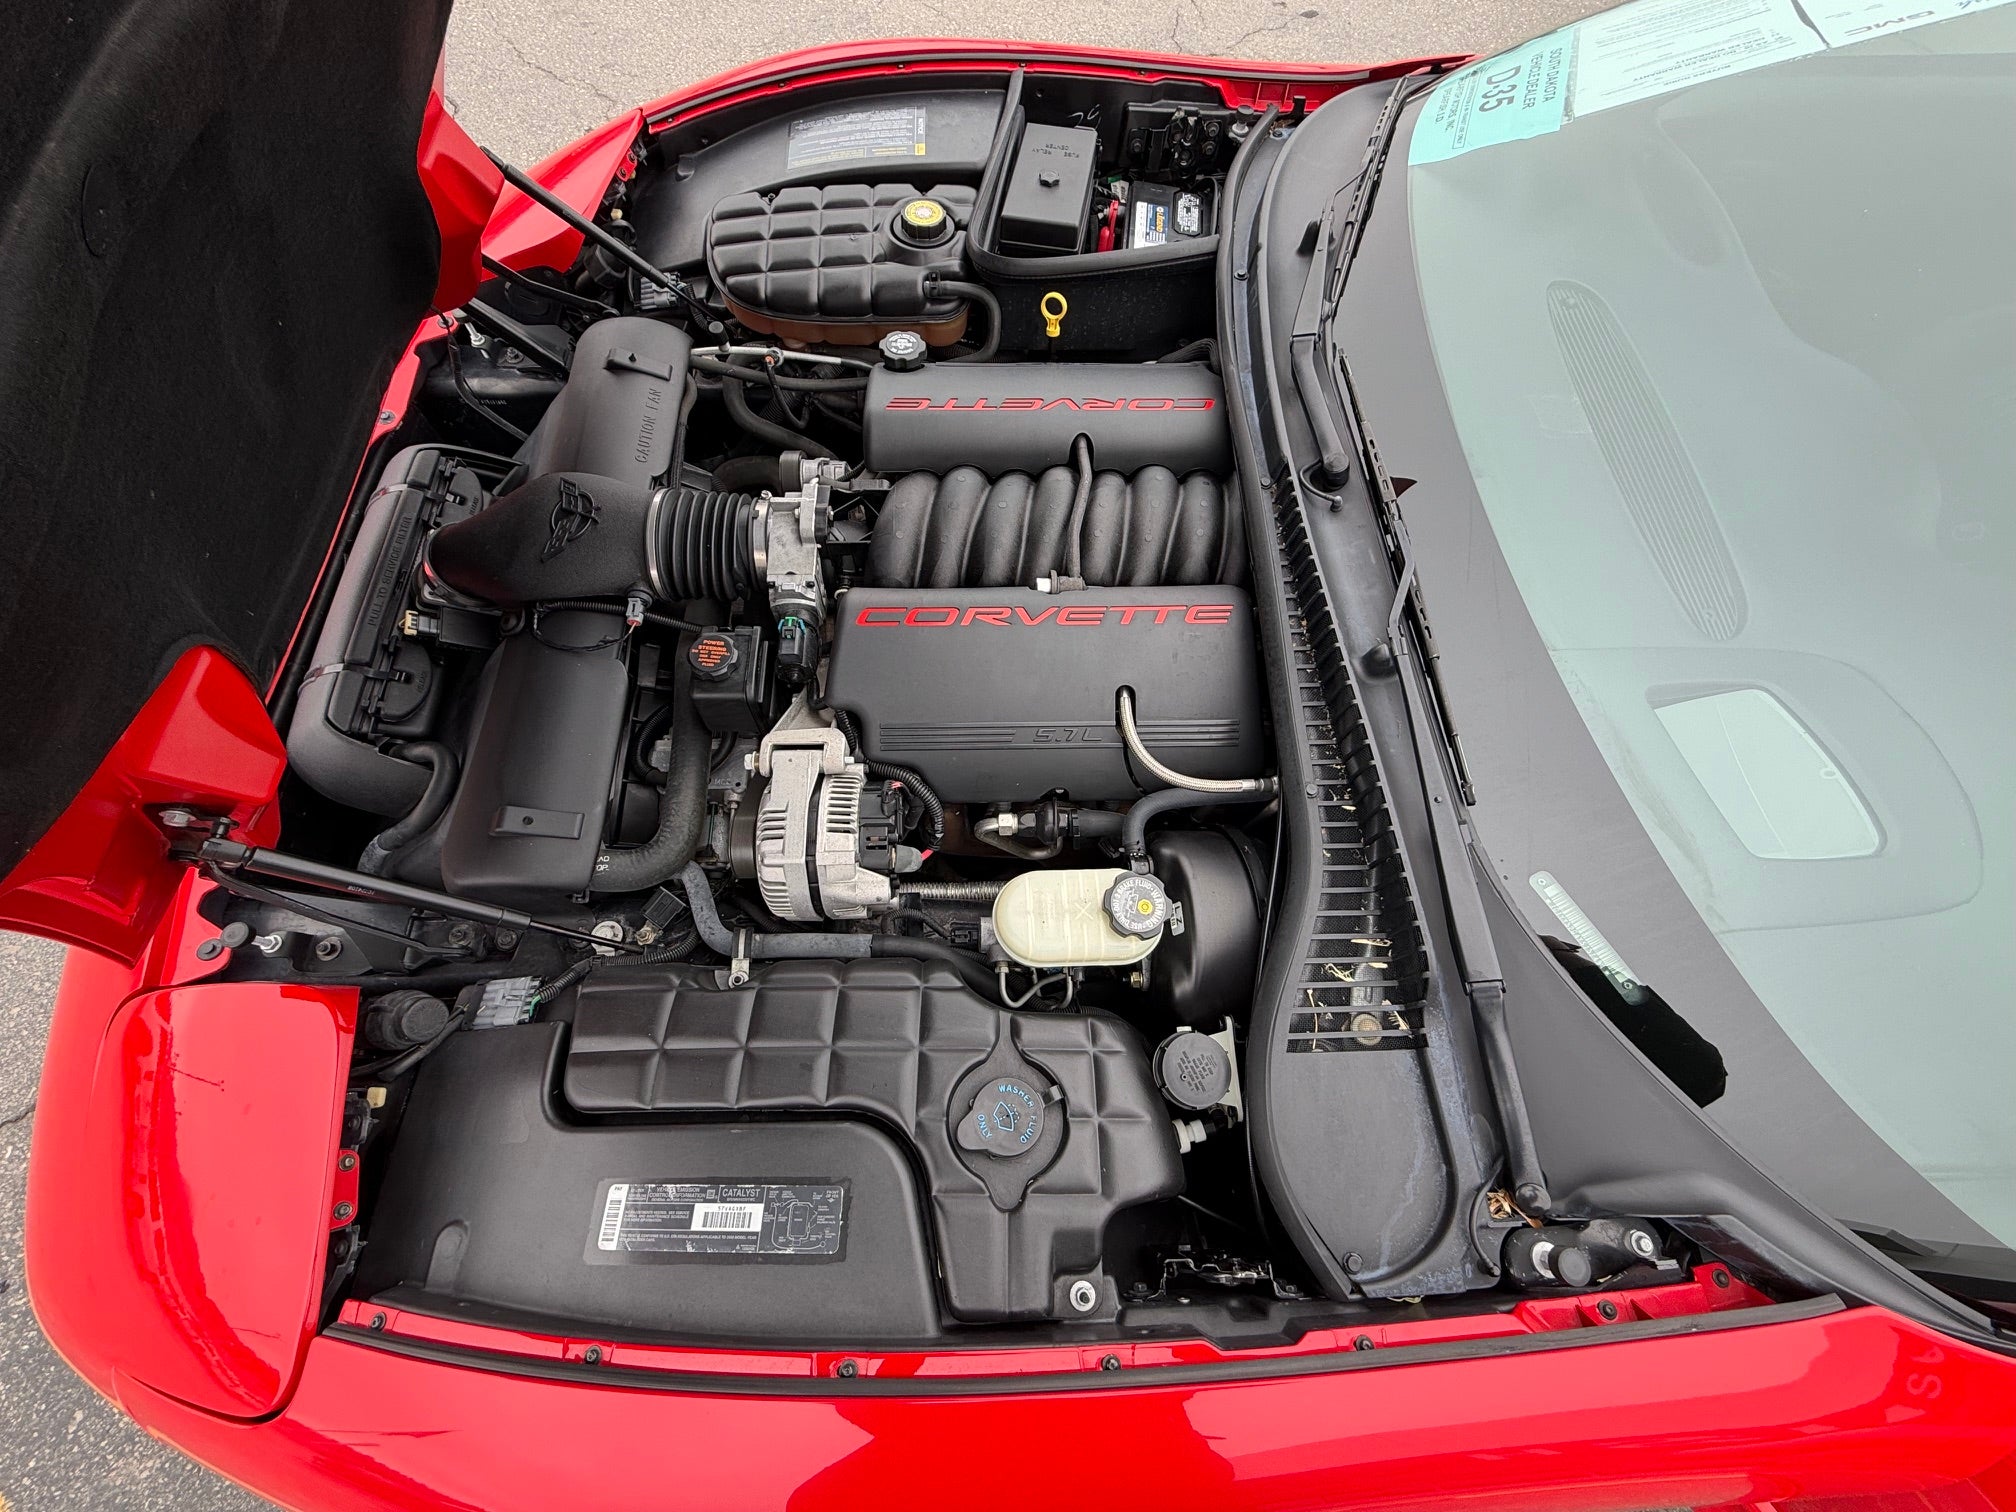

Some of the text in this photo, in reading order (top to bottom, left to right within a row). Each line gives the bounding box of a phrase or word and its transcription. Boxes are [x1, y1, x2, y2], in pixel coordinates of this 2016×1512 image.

[1844, 10, 1935, 36] GMC
[1542, 48, 1563, 103] SOUTH DAKOTA
[1522, 78, 1540, 110] DEALER
[1045, 143, 1070, 151] CENTER
[886, 397, 1216, 411] CORVETTE
[634, 388, 662, 463] CAUTION FAN
[368, 516, 413, 627] PULL TO SERVICE FILTER
[855, 604, 1235, 627] CORVETTE
[1031, 728, 1102, 742] 5.7L
[977, 1114, 993, 1139] ONLY
[998, 1084, 1037, 1144] WASHER FLUID
[722, 1188, 761, 1197] CATALYST
